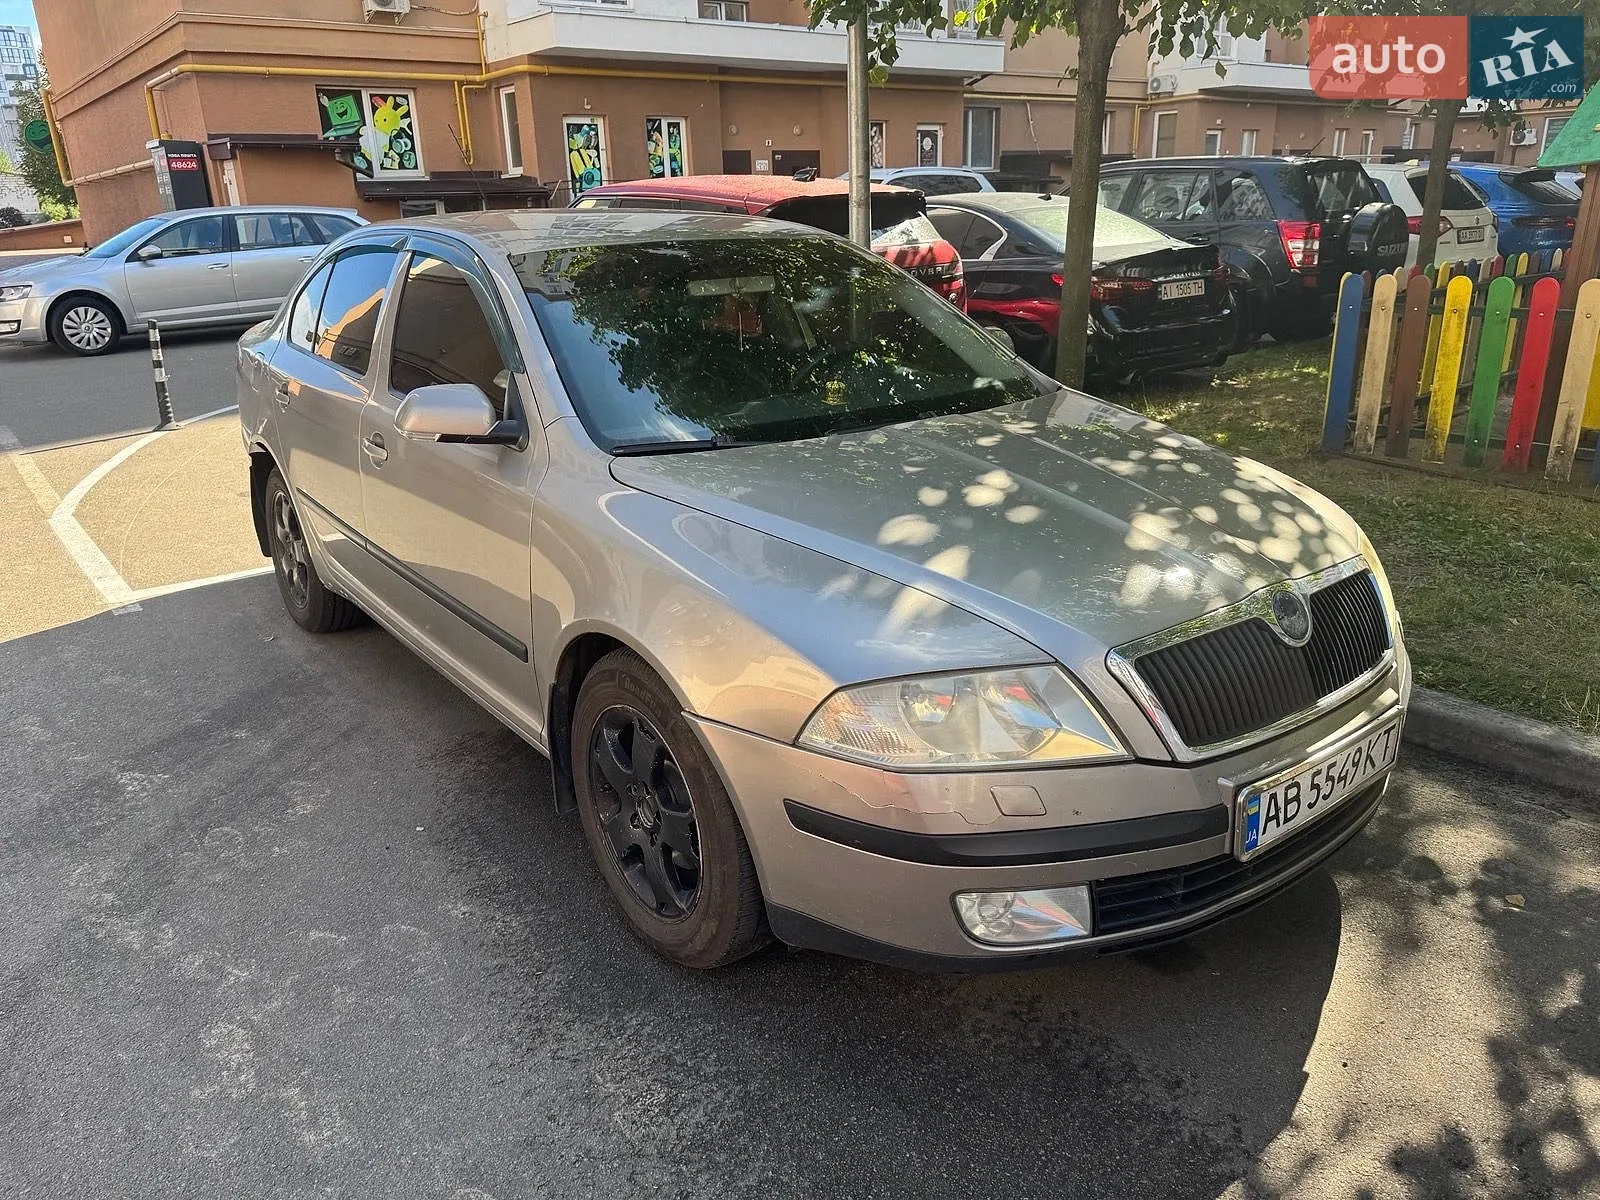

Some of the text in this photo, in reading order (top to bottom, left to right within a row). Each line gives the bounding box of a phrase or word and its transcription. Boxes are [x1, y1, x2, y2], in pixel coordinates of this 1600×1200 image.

[171, 161, 197, 169] 48624
[1193, 280, 1203, 294] TH
[1262, 723, 1397, 836] AB 5549 KT
